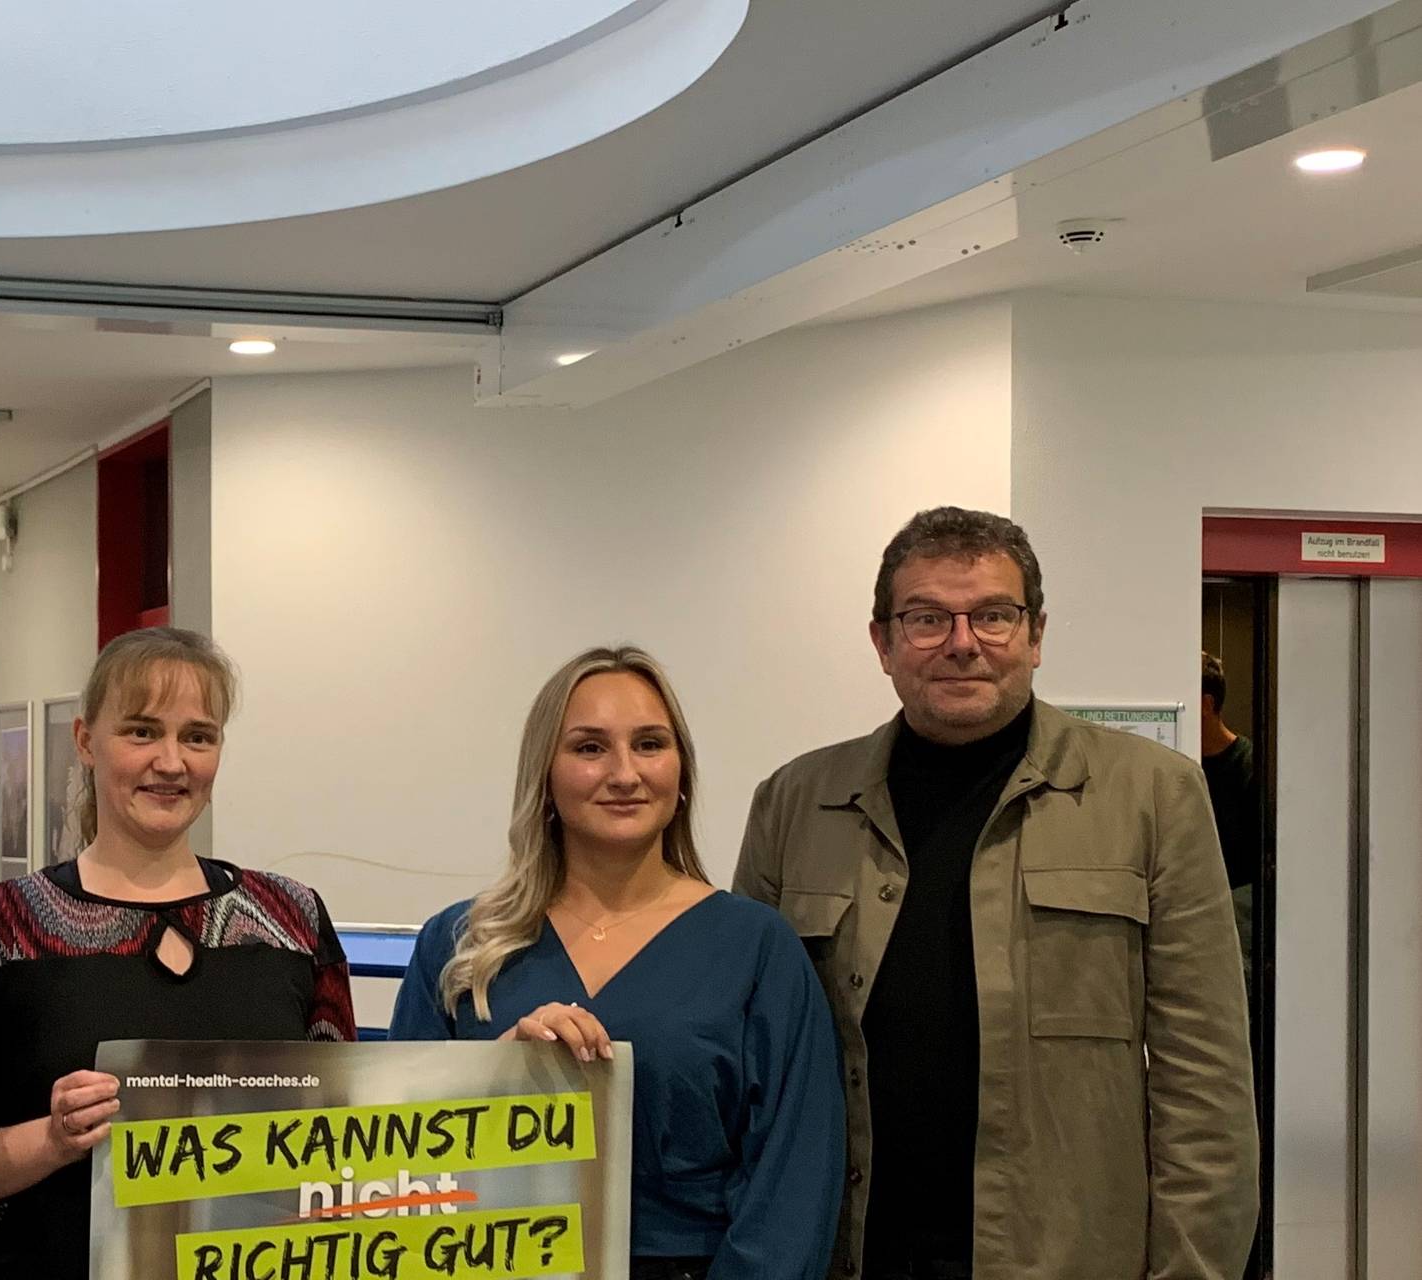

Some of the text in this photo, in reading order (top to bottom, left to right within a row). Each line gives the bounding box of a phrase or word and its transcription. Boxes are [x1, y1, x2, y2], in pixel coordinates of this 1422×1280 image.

[1308, 536, 1333, 547] Aufzug
[1347, 537, 1380, 546] Brandfall
[1338, 550, 1370, 558] benutzen
[1105, 711, 1174, 721] RETTUNGSPLAN
[126, 1073, 320, 1088] mental-health-coaches.de
[125, 1102, 575, 1182] WAS KANNST DU
[298, 1166, 459, 1218] nicht
[194, 1215, 568, 1280] RICHTIG GUT?
